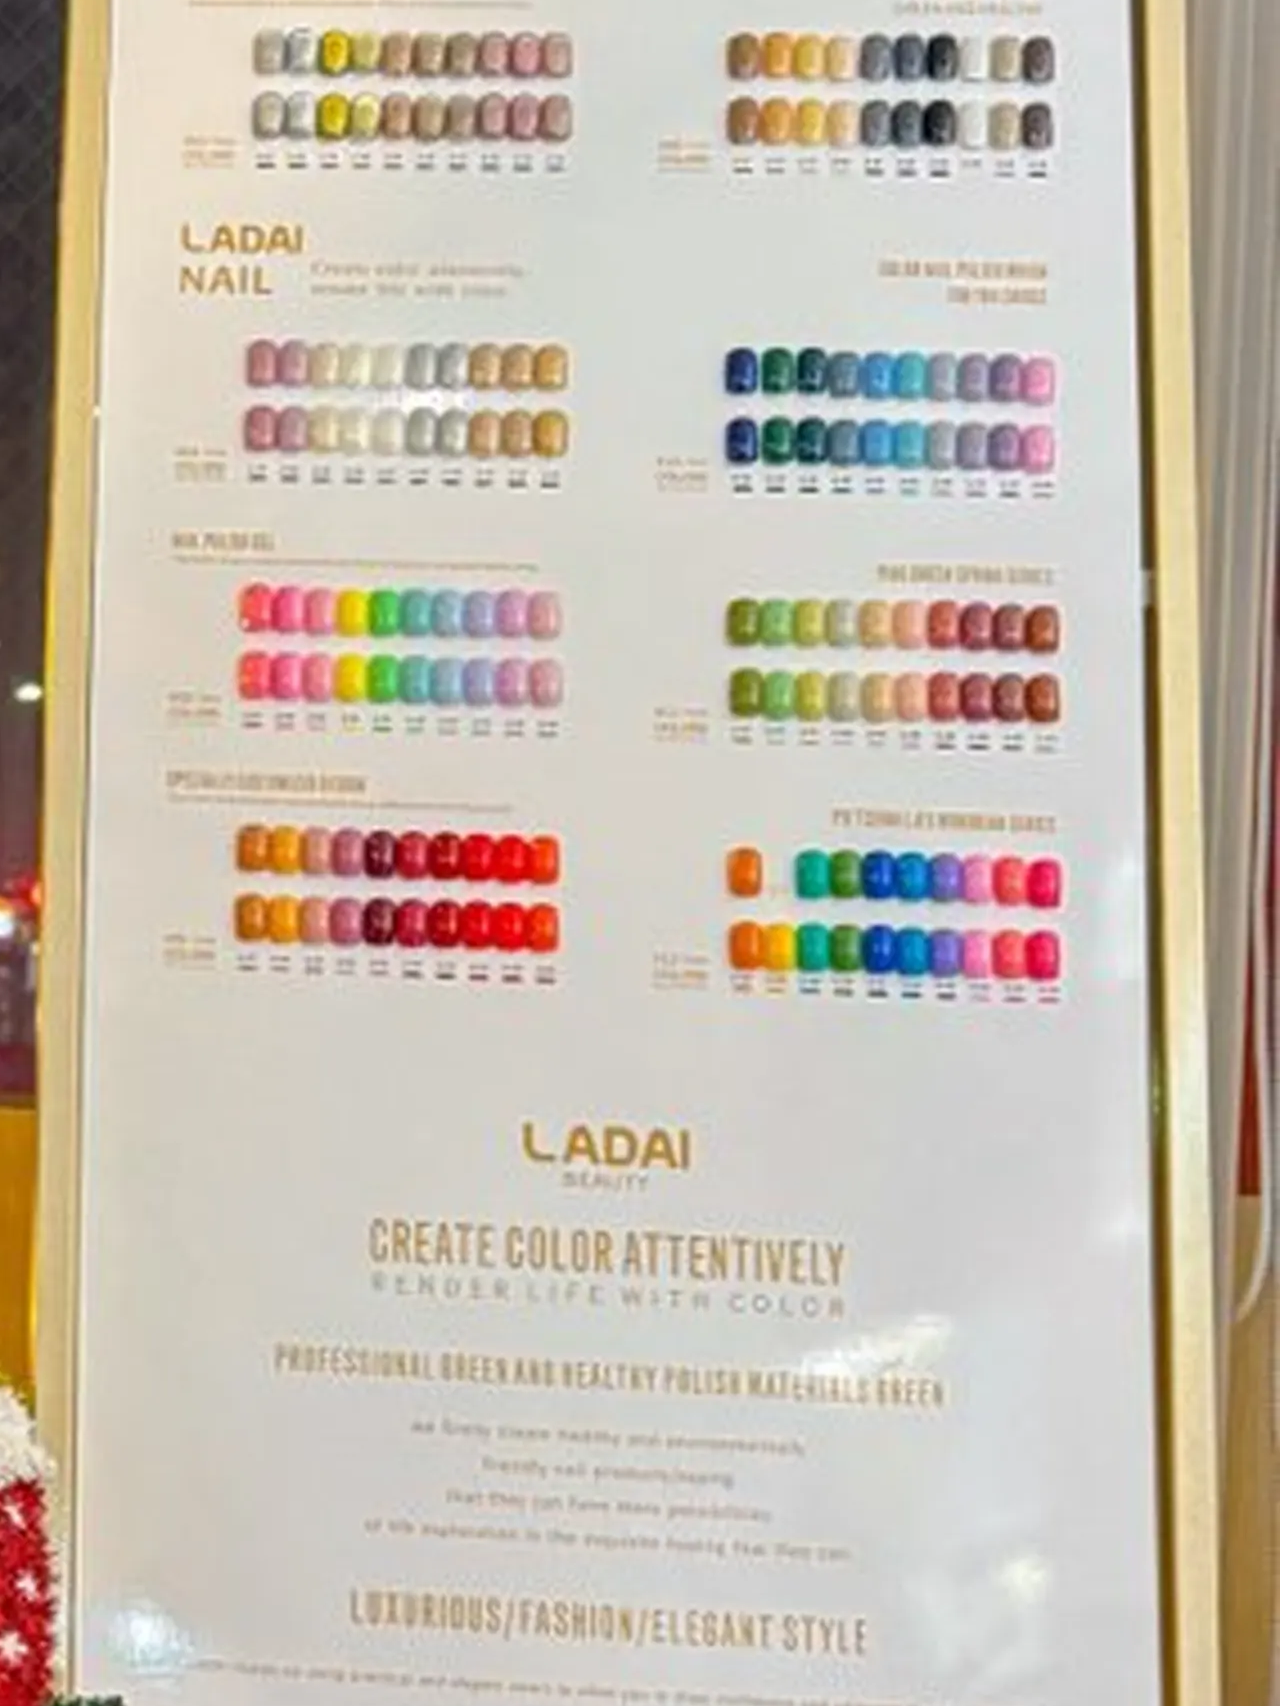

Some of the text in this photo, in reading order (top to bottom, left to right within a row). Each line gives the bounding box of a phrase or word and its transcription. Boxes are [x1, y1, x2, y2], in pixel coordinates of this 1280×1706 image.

[181, 224, 303, 255] LADAI
[180, 265, 274, 295] NAIL
[522, 1122, 690, 1169] LADAI
[562, 1171, 649, 1192] BEAUTY
[367, 1217, 846, 1287] CREATE COLOR ATTENTIVELY
[371, 1271, 846, 1318] RENDER LIFE WITH COLOR
[274, 1342, 436, 1381] PROFESSIONAL
[560, 1358, 658, 1393] HEALTHY
[662, 1364, 741, 1396] POLISH
[782, 1614, 868, 1656] STYLE
